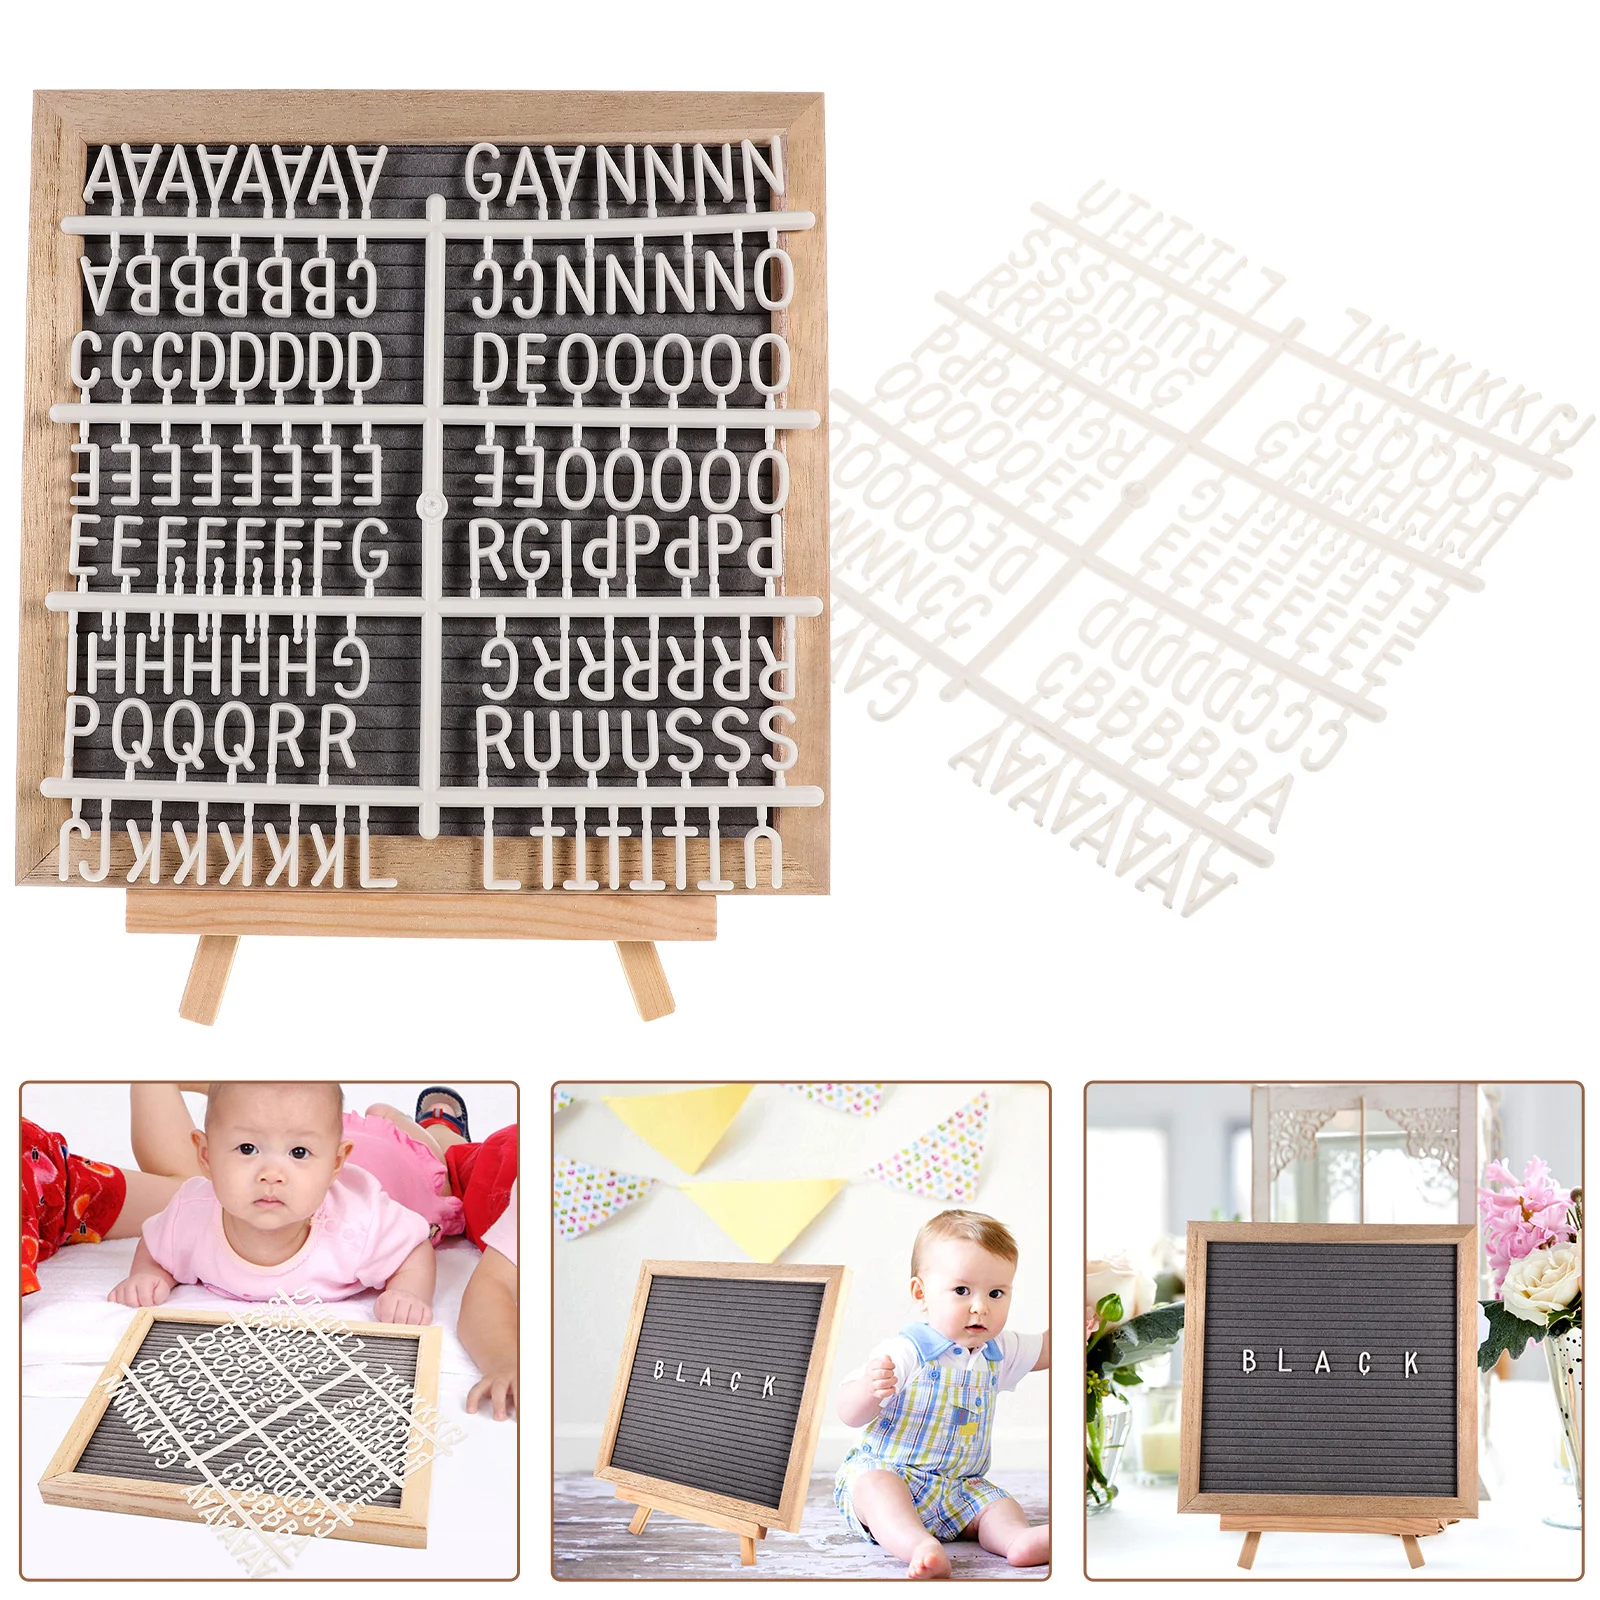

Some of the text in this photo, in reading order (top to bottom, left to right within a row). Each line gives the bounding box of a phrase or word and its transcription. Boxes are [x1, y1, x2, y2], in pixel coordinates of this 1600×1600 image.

[71, 331, 383, 391] CCCDDDDD
[473, 332, 791, 394] DEOOOOO
[63, 696, 358, 771] PQQQRR
[475, 705, 798, 772] RUUUSSS
[653, 1361, 776, 1399] BLACK
[1243, 1348, 1419, 1378] BLACK
